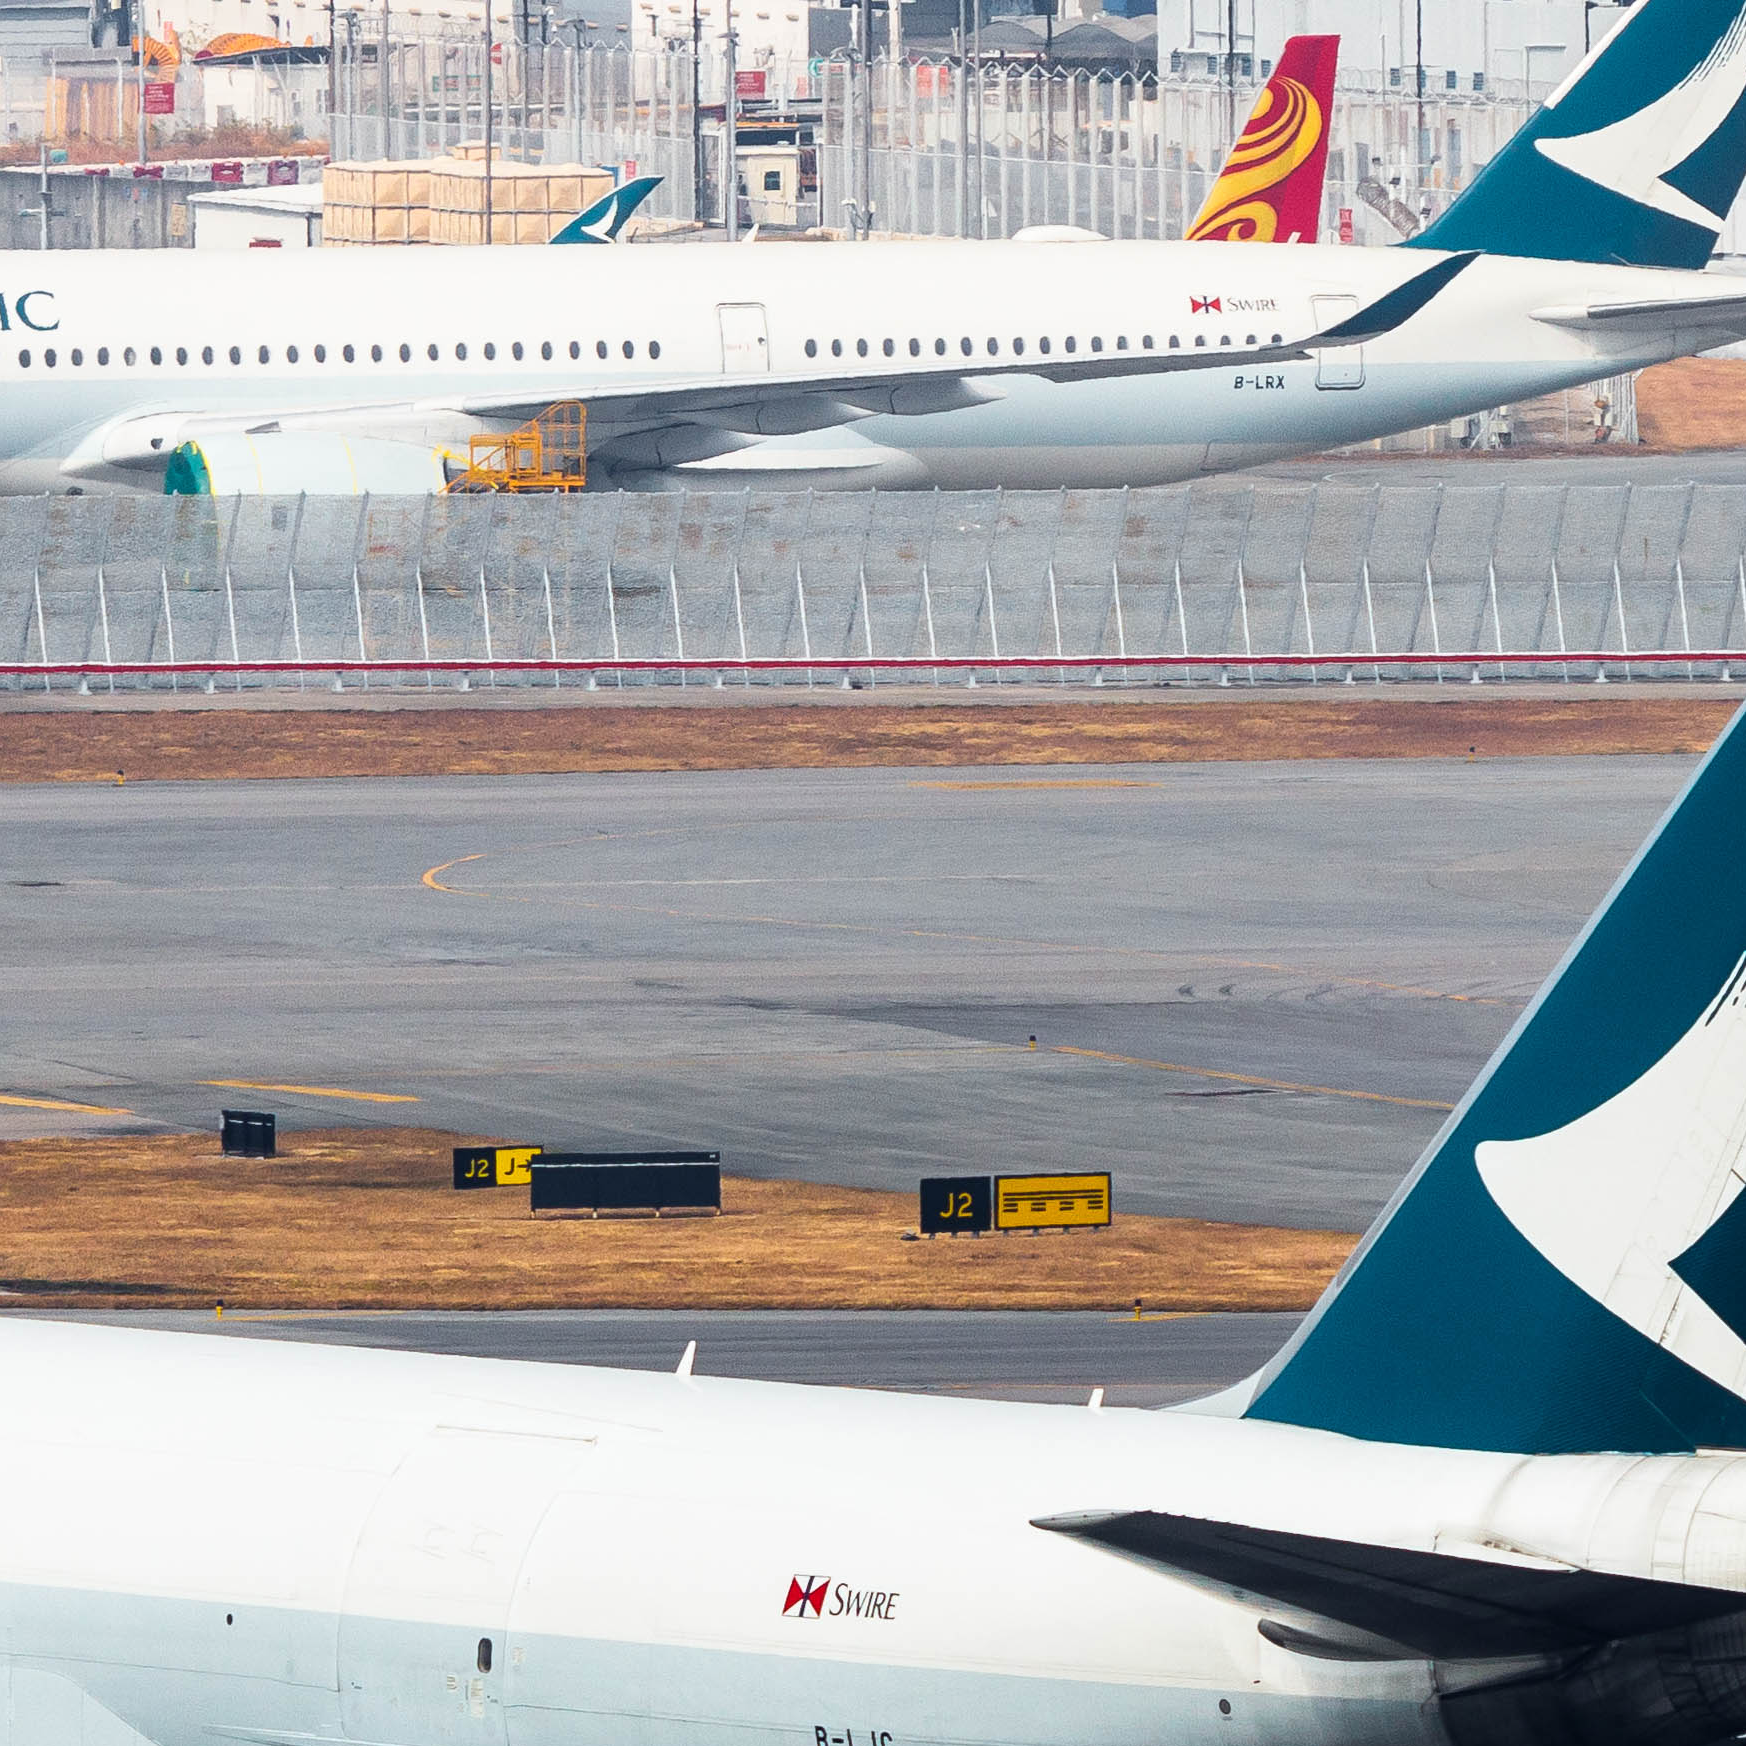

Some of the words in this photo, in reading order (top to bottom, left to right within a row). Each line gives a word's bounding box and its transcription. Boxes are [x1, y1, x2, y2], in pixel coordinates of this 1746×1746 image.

[1227, 297, 1280, 312] SWIRE
[1234, 375, 1285, 390] B-LRX
[465, 1159, 490, 1178] J2
[505, 1158, 515, 1176] J
[940, 1192, 973, 1219] J2
[829, 1583, 900, 1620] SWIRE
